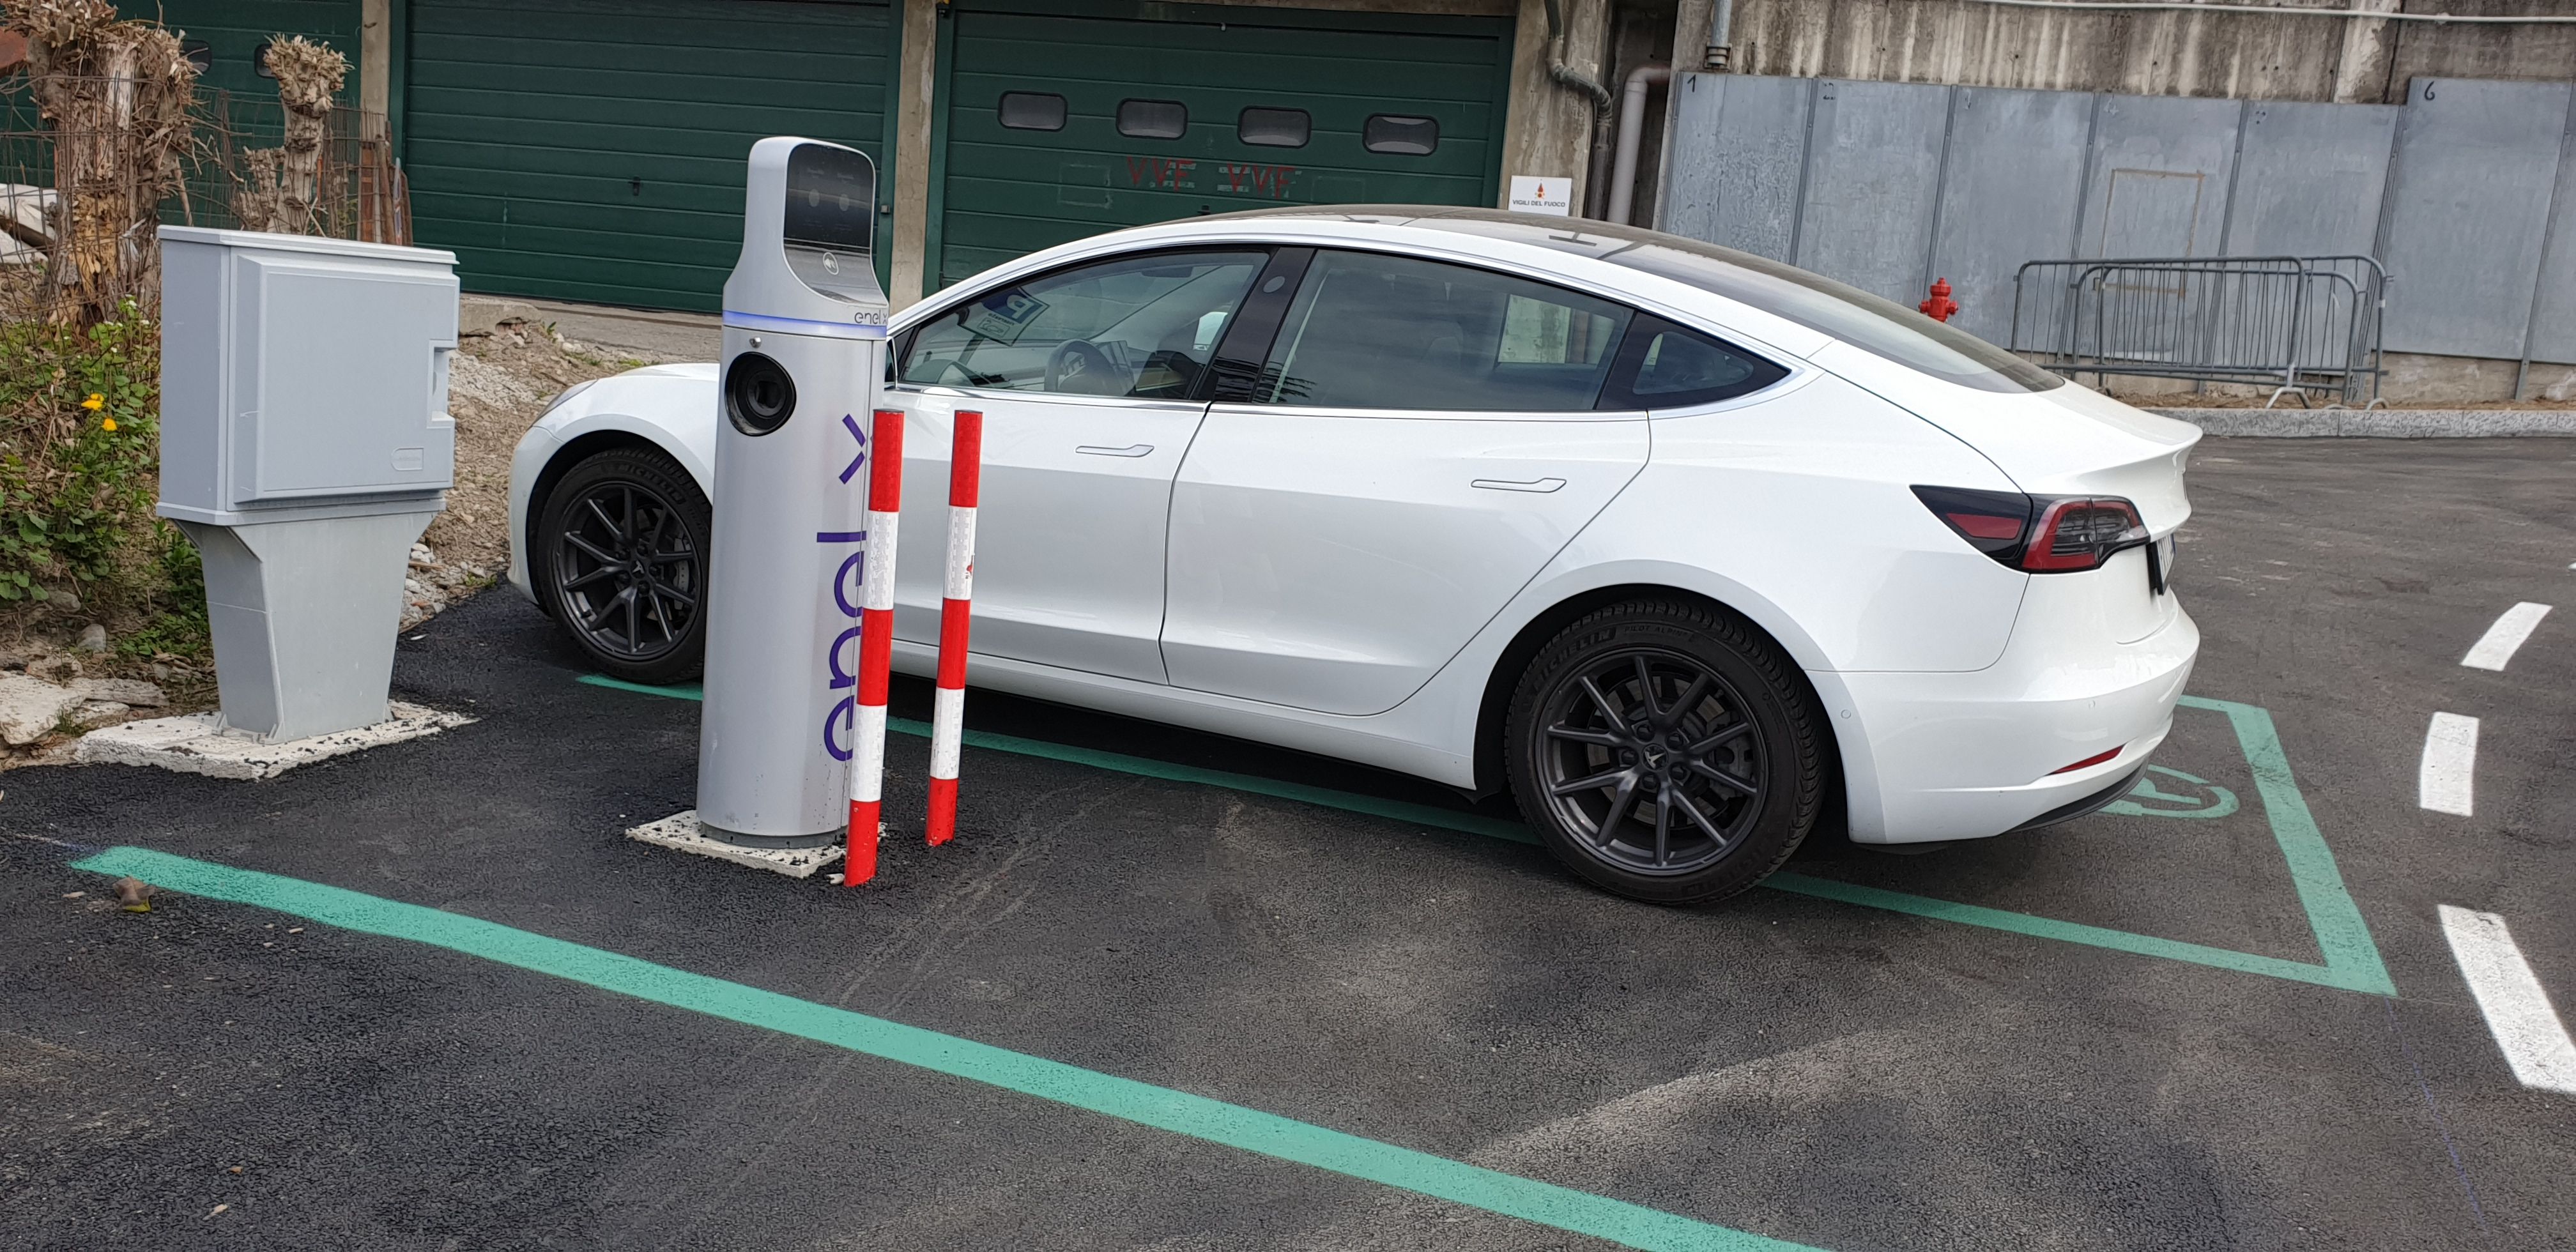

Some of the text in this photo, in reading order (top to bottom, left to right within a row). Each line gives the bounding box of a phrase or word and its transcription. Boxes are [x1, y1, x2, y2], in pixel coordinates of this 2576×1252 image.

[1687, 74, 1696, 93] 1
[2424, 80, 2435, 101] 6
[854, 309, 881, 324] enel
